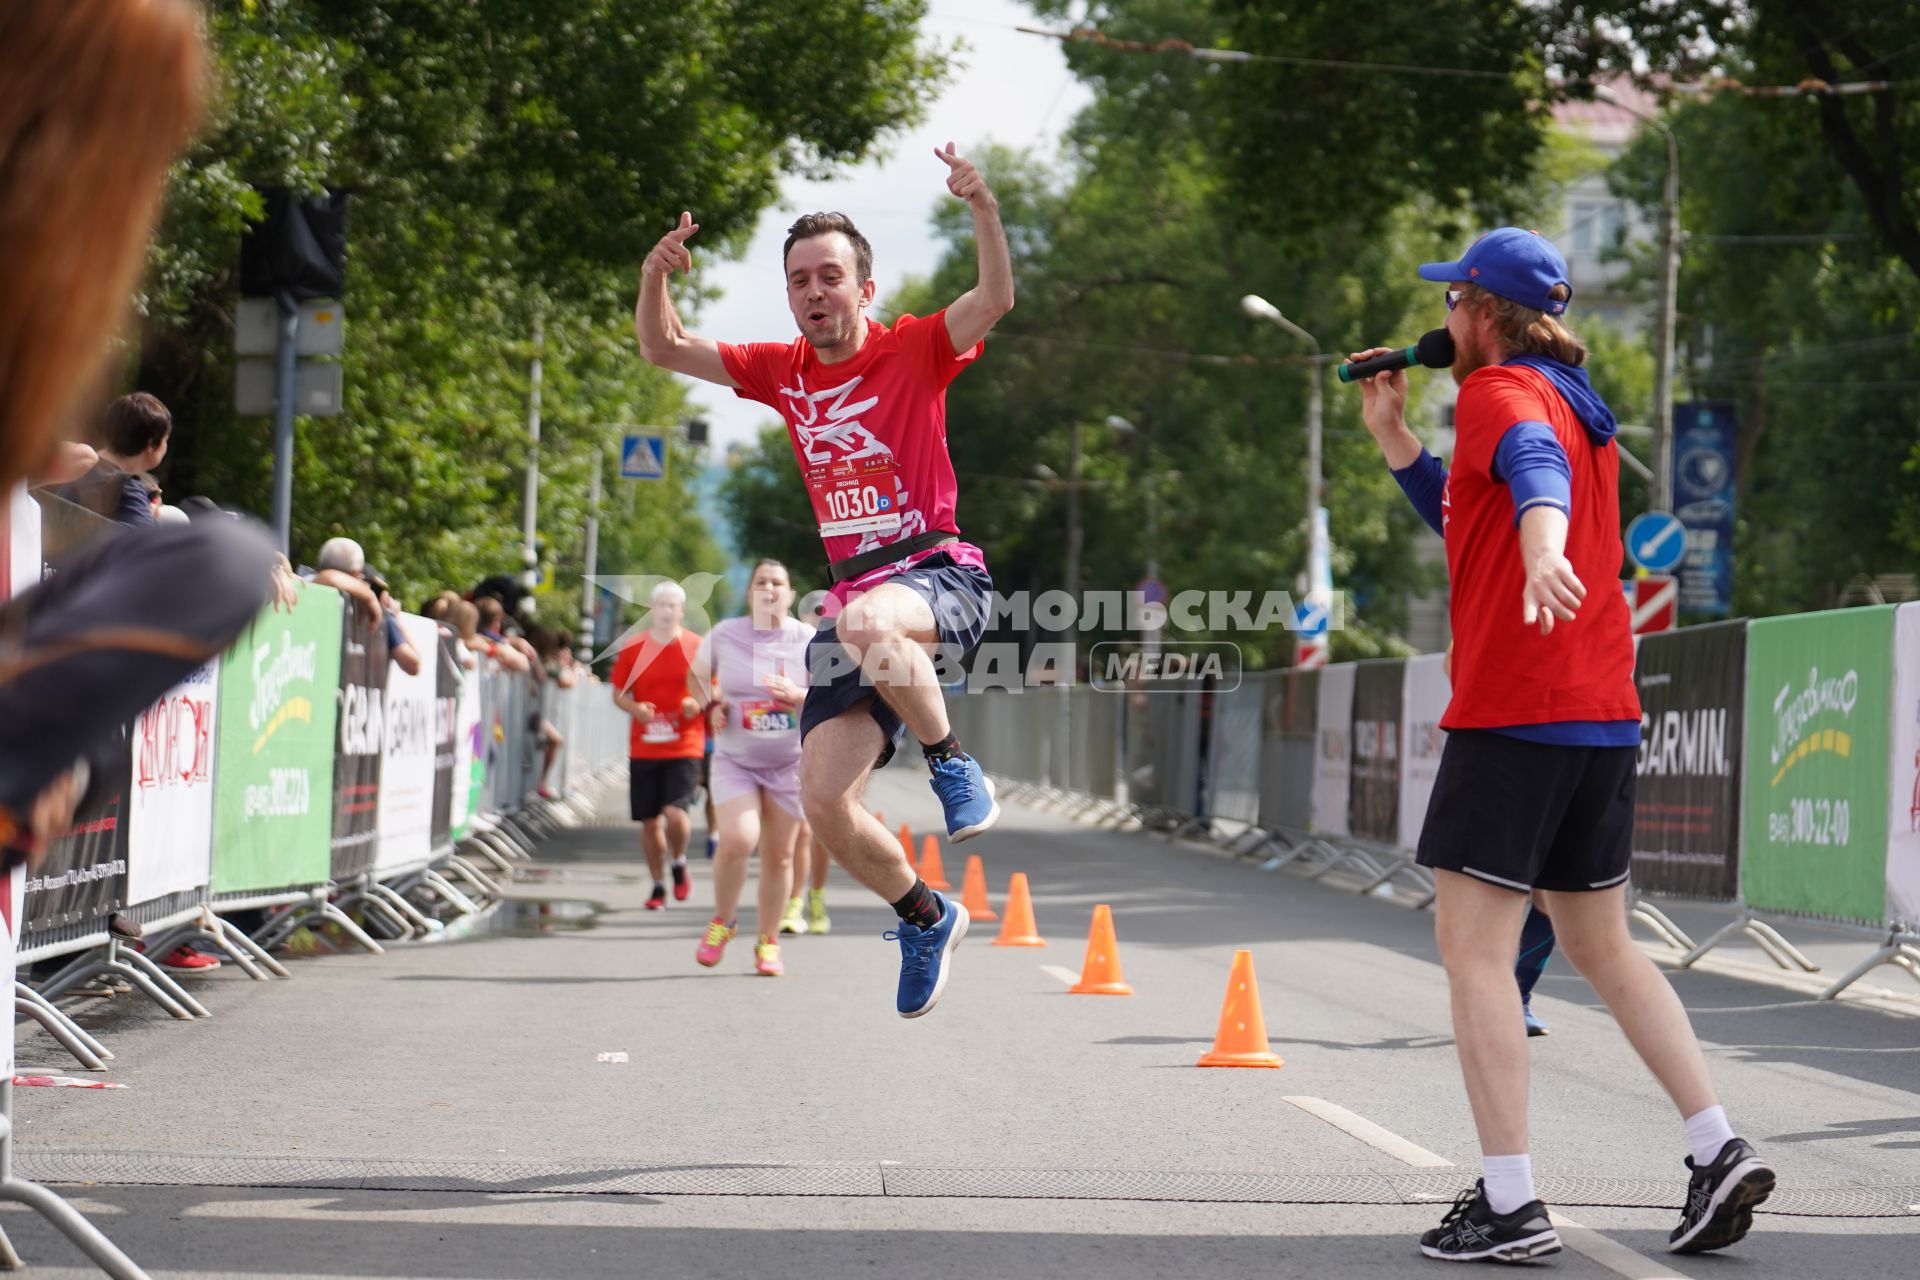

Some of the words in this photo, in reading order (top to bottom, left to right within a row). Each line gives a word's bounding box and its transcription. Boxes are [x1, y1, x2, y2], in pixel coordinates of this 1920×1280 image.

[836, 479, 860, 488] ЛЕОНИД
[825, 486, 880, 520] 1030
[880, 498, 890, 508] D
[752, 713, 789, 730] 5043
